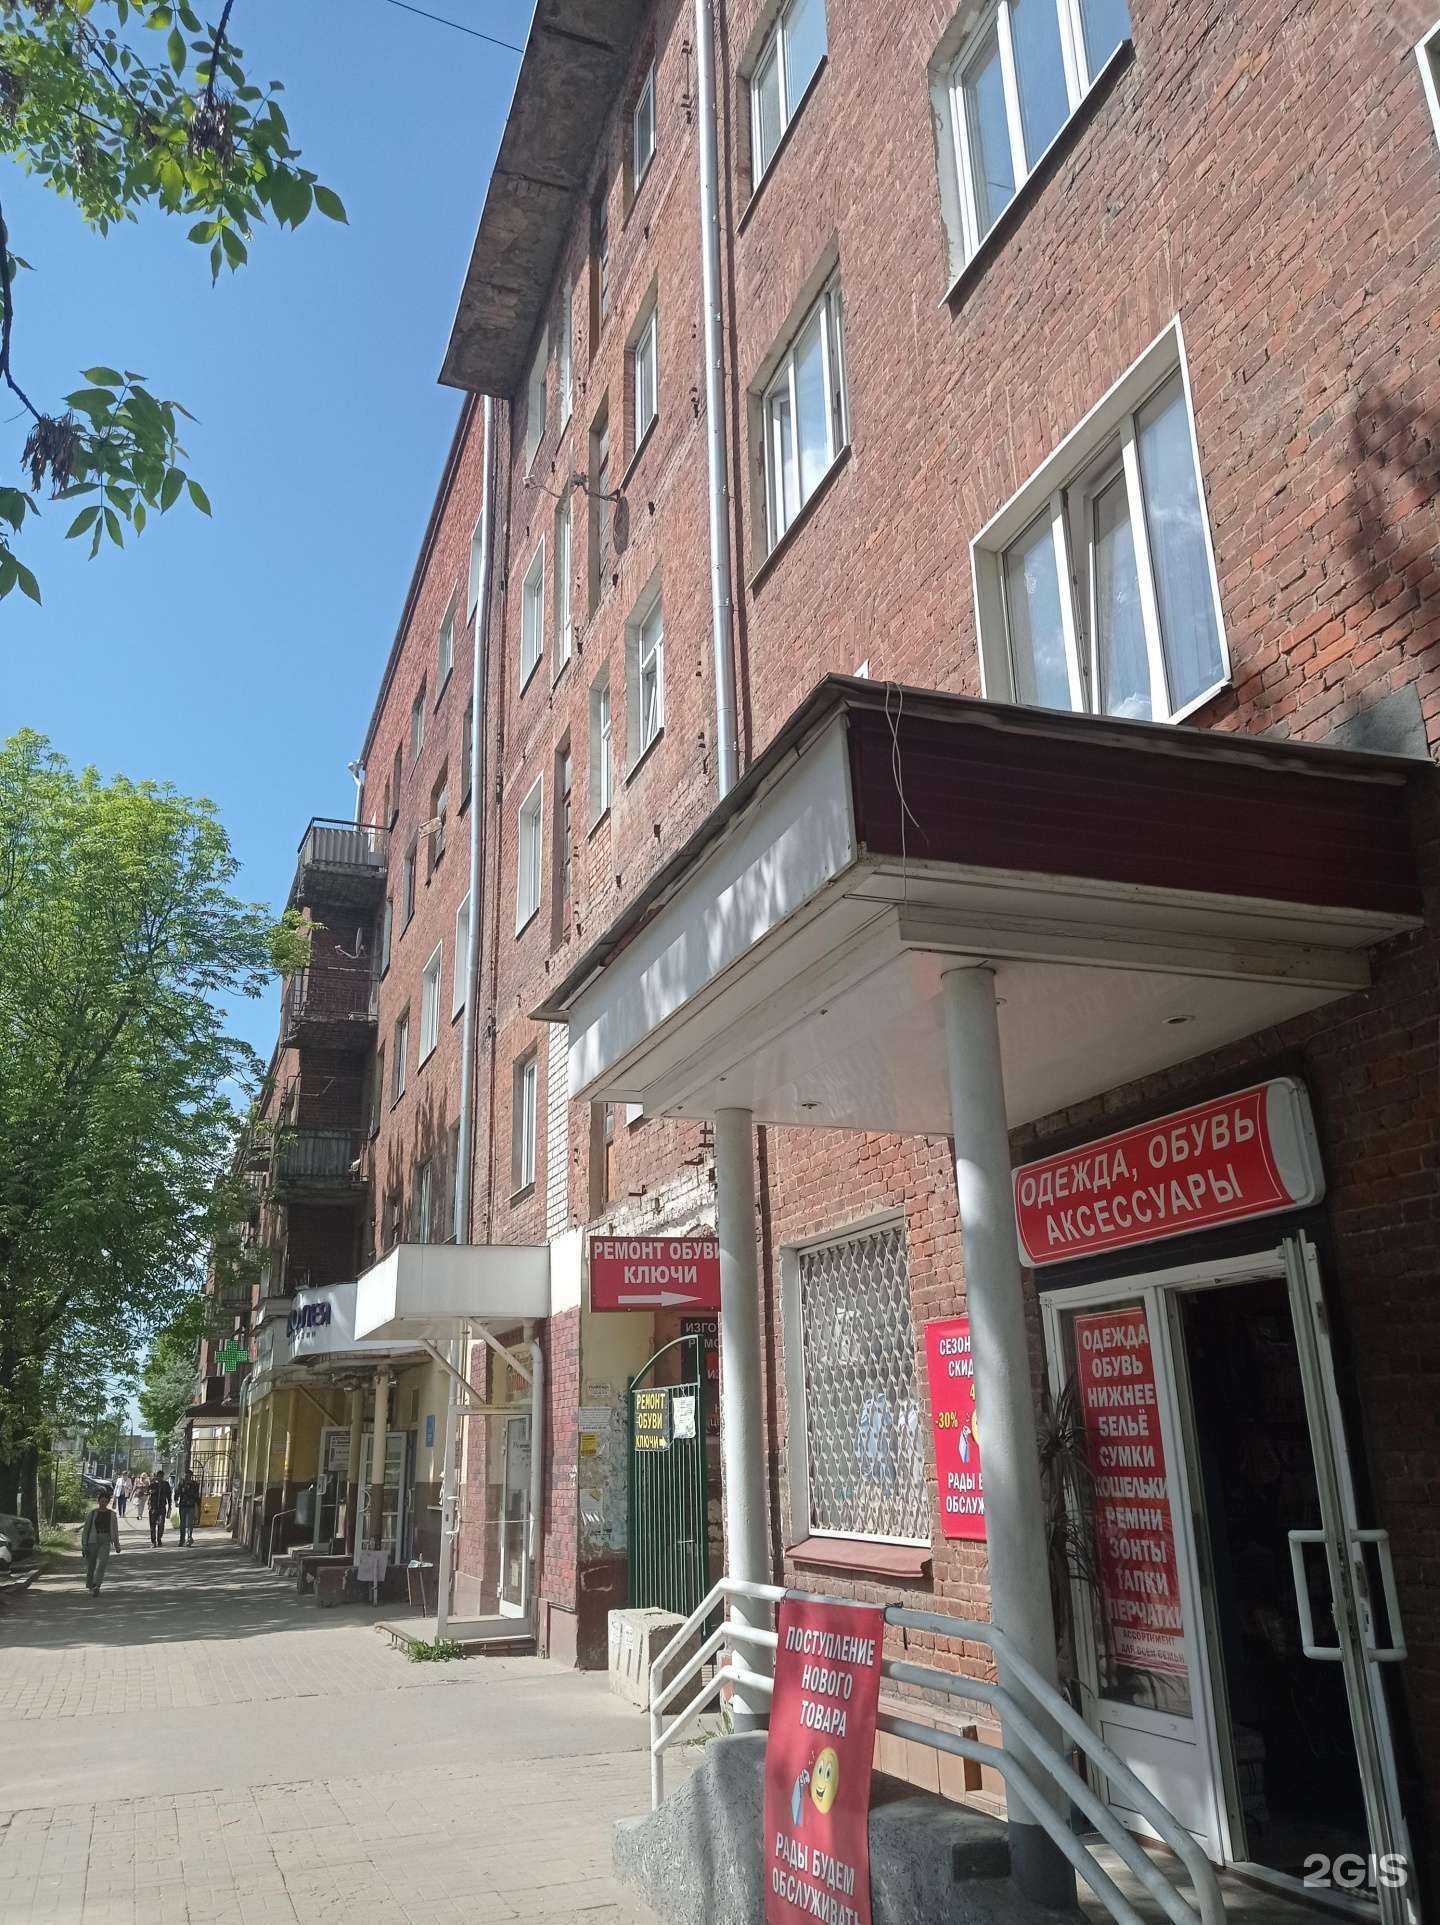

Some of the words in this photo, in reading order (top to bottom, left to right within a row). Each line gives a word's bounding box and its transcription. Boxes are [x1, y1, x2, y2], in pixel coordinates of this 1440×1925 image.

[1020, 1148, 1138, 1209] ОДЕЖДА,
[1149, 1107, 1255, 1169] ОБУВЬ
[1046, 1163, 1244, 1245] АКСЕССУАРЫ
[594, 1241, 664, 1260] РЕМОНТ
[623, 1265, 697, 1284] КЛЮЧИ
[1082, 1324, 1150, 1353] ОДЕЖДА
[1091, 1354, 1144, 1378] ОБУВЬ
[636, 1392, 666, 1410] РЕМОНТ
[1087, 1383, 1156, 1408] НИЖНЕЕ
[638, 1412, 663, 1429] ОБУВИ
[935, 1411, 959, 1429] -30%
[1098, 1408, 1150, 1437] БЕЛЬЁ
[635, 1434, 660, 1449] КЛЮЧИ
[1099, 1445, 1155, 1468] СУМКИ
[947, 1471, 976, 1493] РАДЫ
[1105, 1507, 1164, 1531] РЕМНИ
[1109, 1538, 1168, 1564] ЗОНТЫ
[1116, 1568, 1169, 1596] ТАПКИ
[785, 1625, 876, 1667] ПОСТУПЛЕНИЕ
[801, 1664, 853, 1700] НОВОГО
[799, 1699, 847, 1737] ТОВАРА
[775, 1831, 808, 1872] РАДЫ
[812, 1848, 855, 1897] БУДЕМ
